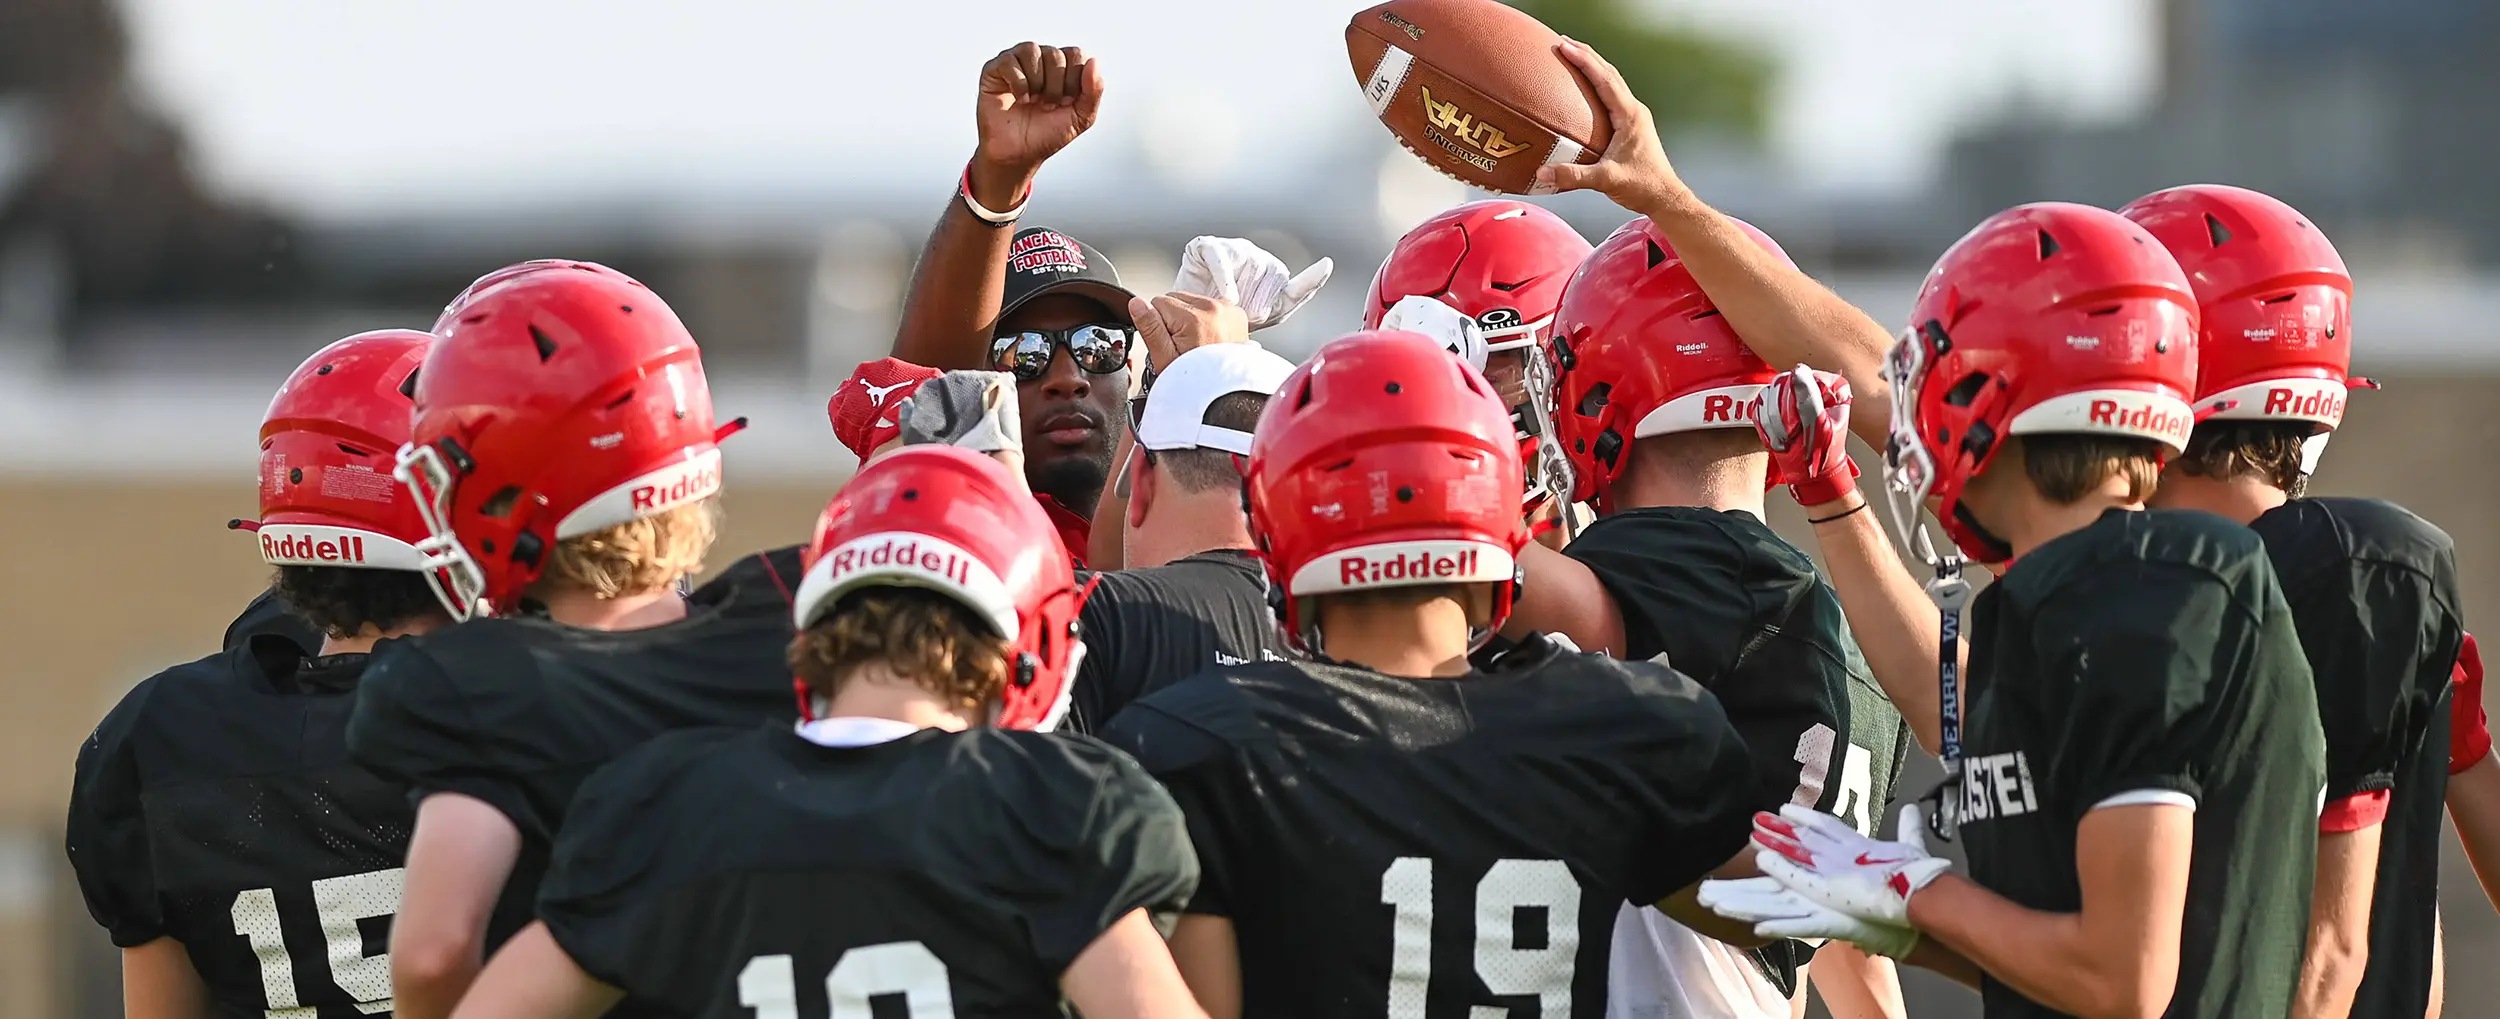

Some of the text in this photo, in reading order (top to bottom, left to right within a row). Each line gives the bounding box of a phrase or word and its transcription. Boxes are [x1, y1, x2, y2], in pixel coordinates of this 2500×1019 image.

[1371, 76, 1390, 102] LHS
[1421, 85, 1532, 158] ALPHA
[1424, 125, 1497, 173] SPALDING
[1676, 342, 1707, 352] Riddell
[2090, 399, 2190, 441] Riddell
[261, 533, 365, 563] Riddell
[831, 539, 970, 585] Riddell
[1340, 549, 1477, 585] Riddell
[1942, 662, 1957, 719] ARE
[1381, 857, 1582, 1019] 19
